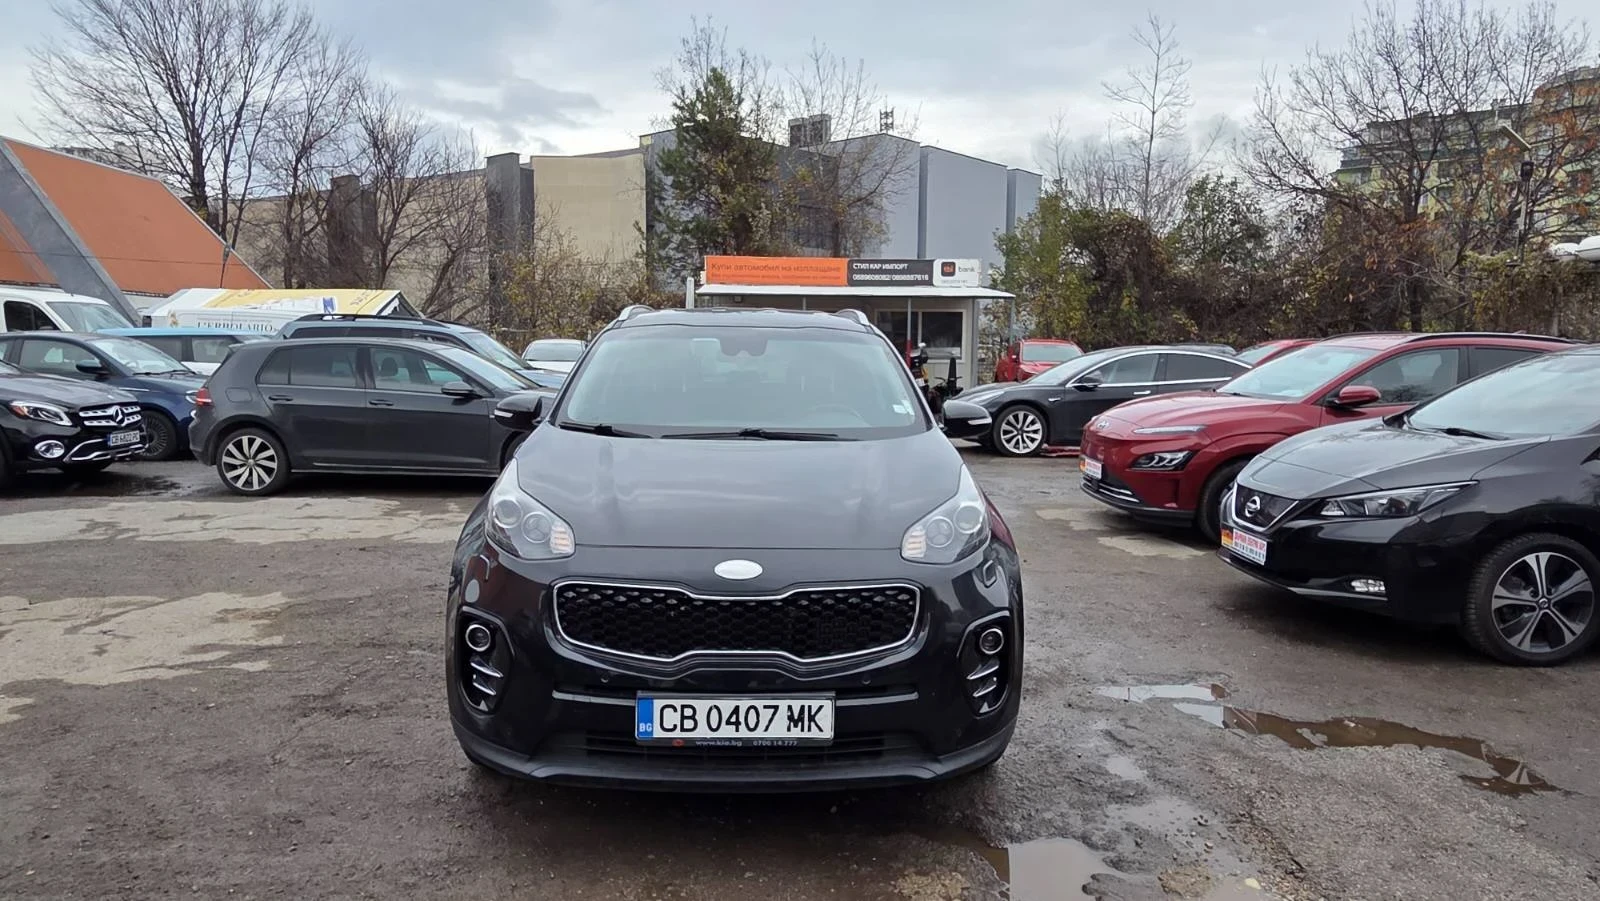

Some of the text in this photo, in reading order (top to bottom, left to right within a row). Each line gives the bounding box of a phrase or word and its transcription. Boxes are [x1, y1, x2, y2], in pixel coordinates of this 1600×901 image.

[711, 263, 732, 273] Купи
[734, 264, 779, 272] автомобил
[659, 704, 824, 733] CB 0407 MK
[639, 723, 653, 732] BG
[695, 739, 743, 747] www.kia.bg
